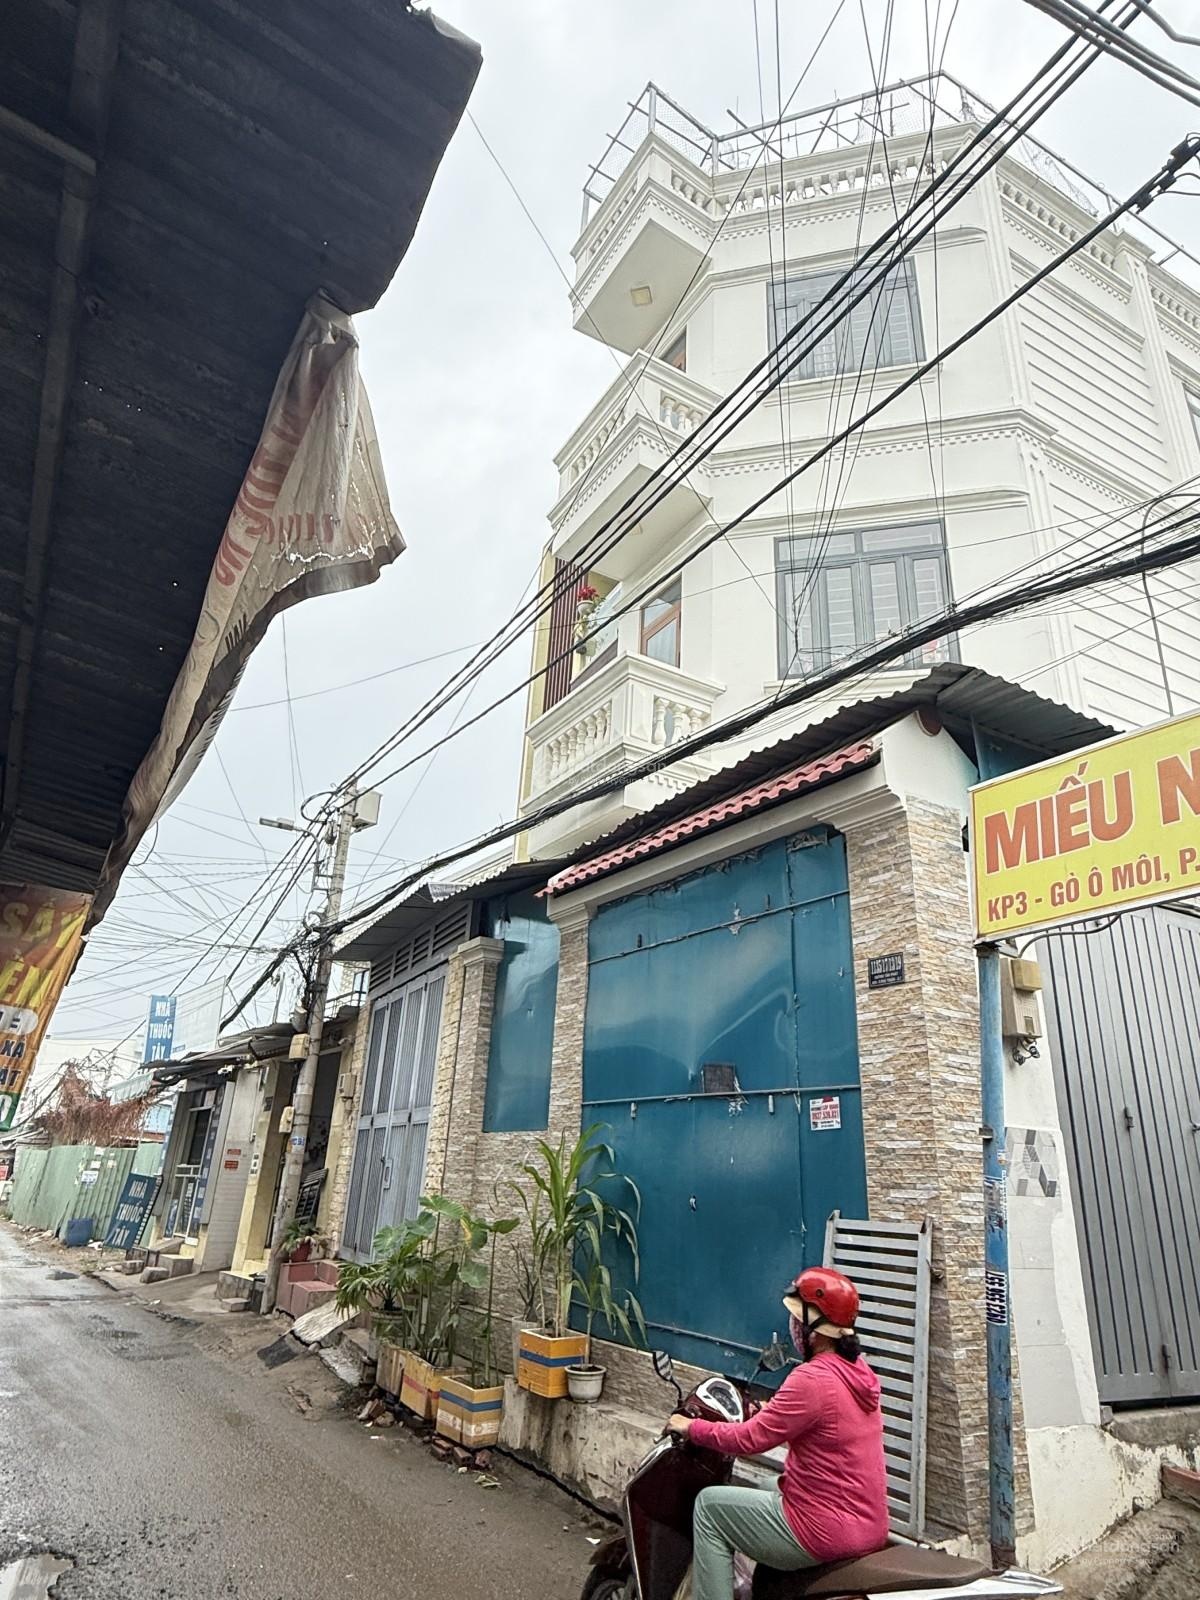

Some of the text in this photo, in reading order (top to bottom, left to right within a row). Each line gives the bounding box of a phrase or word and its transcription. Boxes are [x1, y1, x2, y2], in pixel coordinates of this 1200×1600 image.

[984, 761, 1134, 875] MIẾU
[987, 891, 1028, 922] KP3
[1050, 872, 1080, 907] GÒ
[1088, 867, 1103, 897] Ô
[1111, 854, 1171, 893] MÔI,
[149, 1019, 173, 1039] THUỐC
[128, 1179, 149, 1199] NHÀ
[116, 1200, 144, 1223] THUỐC
[111, 1225, 130, 1246] TÂY
